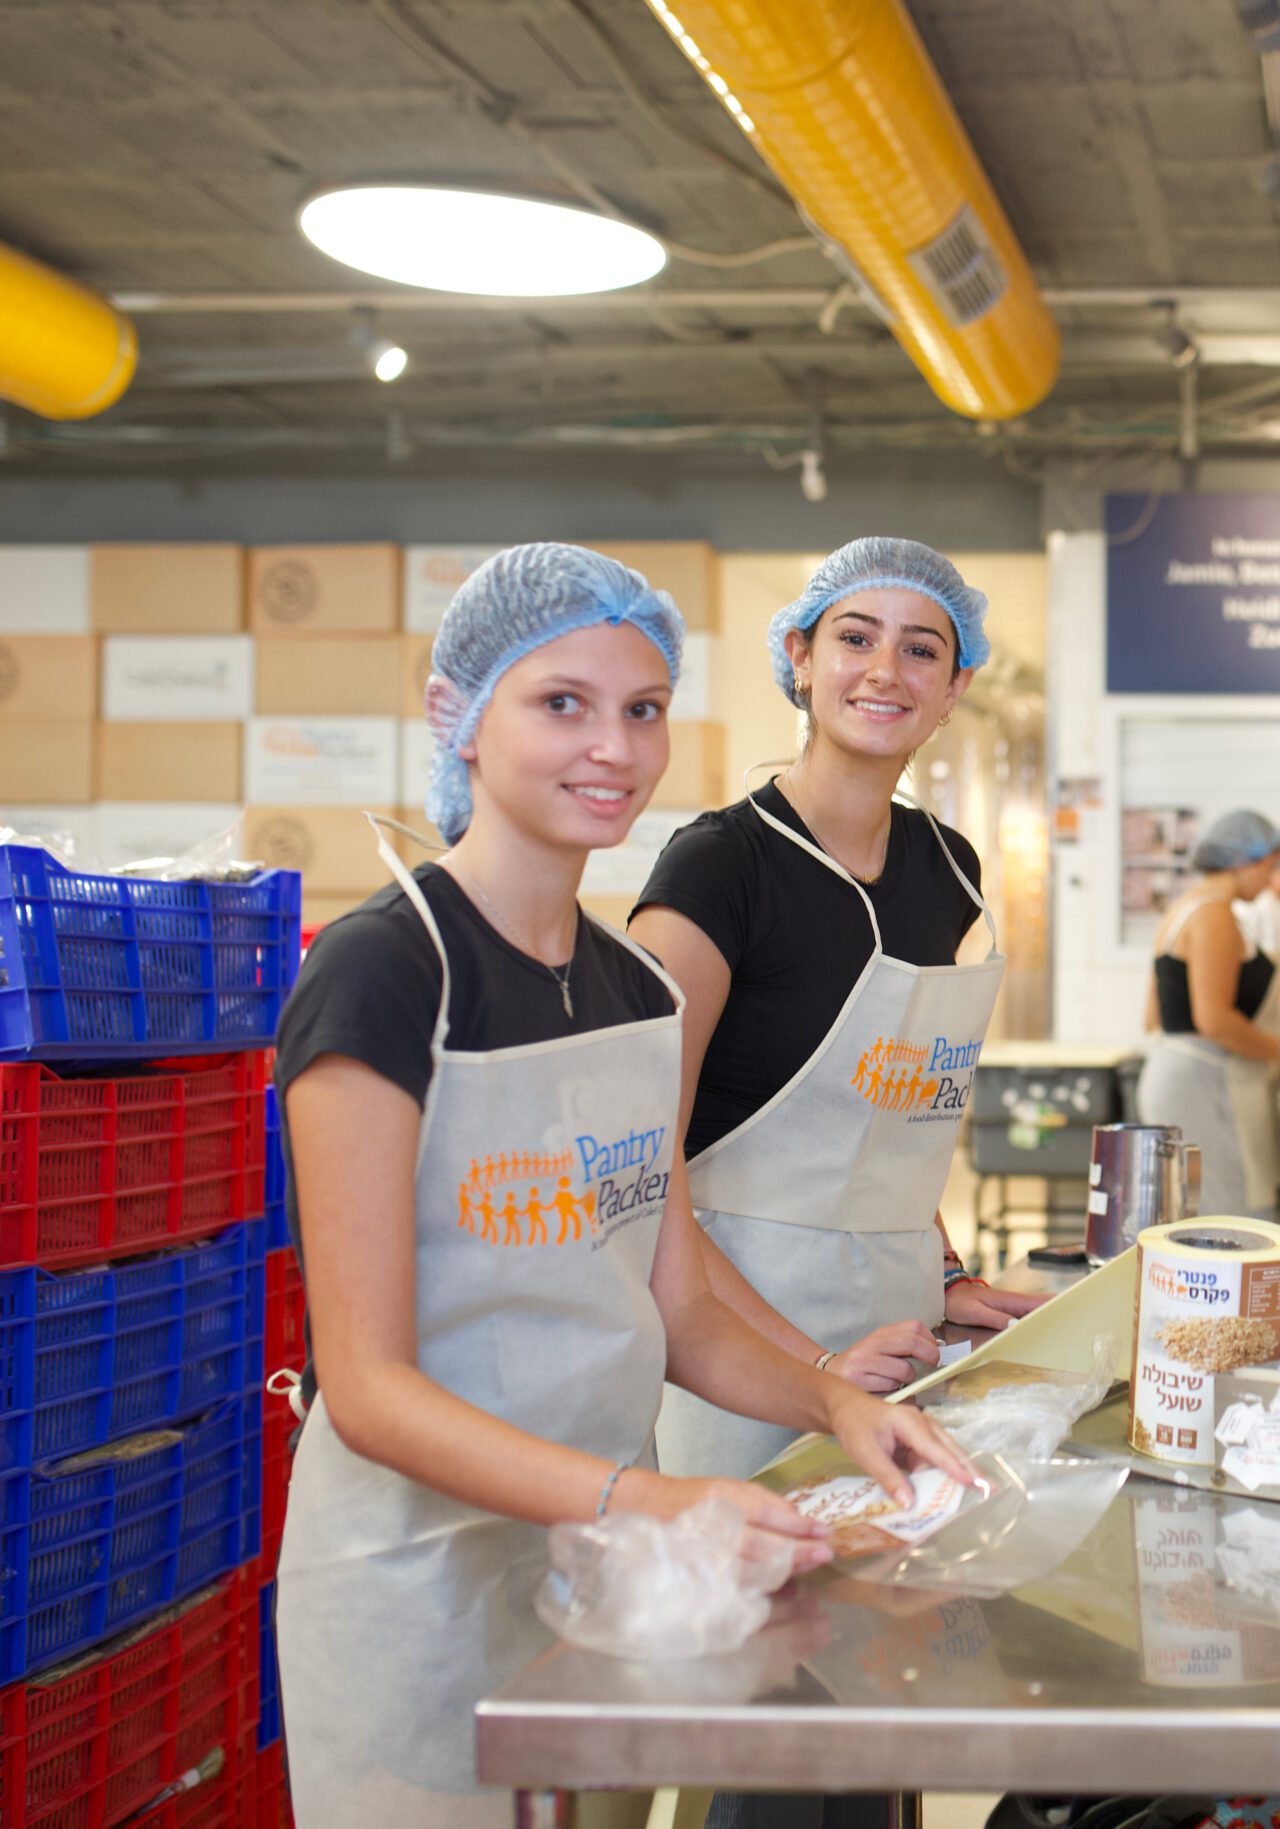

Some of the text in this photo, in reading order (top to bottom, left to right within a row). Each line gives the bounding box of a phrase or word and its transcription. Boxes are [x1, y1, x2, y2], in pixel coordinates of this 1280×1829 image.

[575, 1126, 666, 1184] Pantry
[597, 1165, 671, 1224] Packer
[1177, 1268, 1218, 1286] פנטרי
[1188, 1286, 1230, 1304] פקרס
[1142, 1363, 1203, 1391] שיבולת
[1156, 1387, 1202, 1412] שועל
